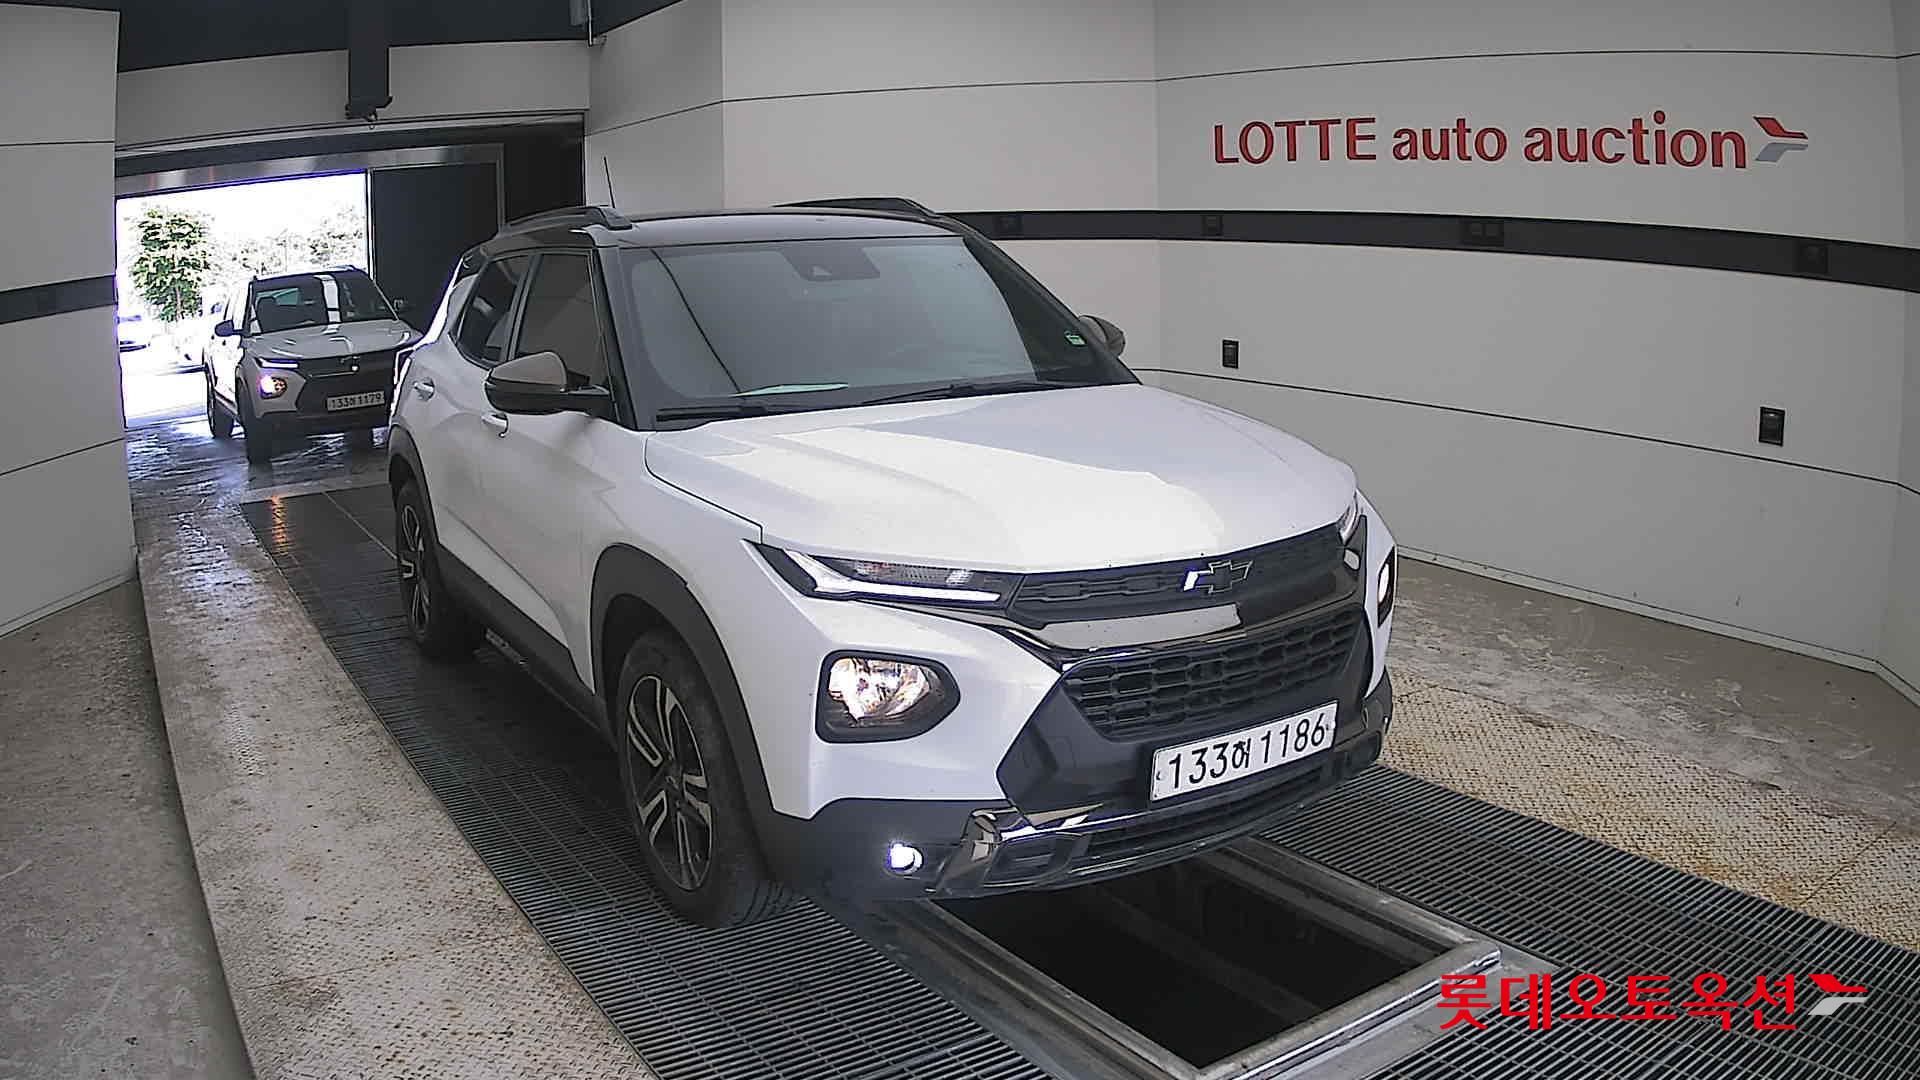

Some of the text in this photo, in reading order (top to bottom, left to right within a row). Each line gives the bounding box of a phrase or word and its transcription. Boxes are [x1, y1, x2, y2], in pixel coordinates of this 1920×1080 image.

[1213, 111, 1747, 168] LOTTE auto auction
[1260, 712, 1326, 764] 1186
